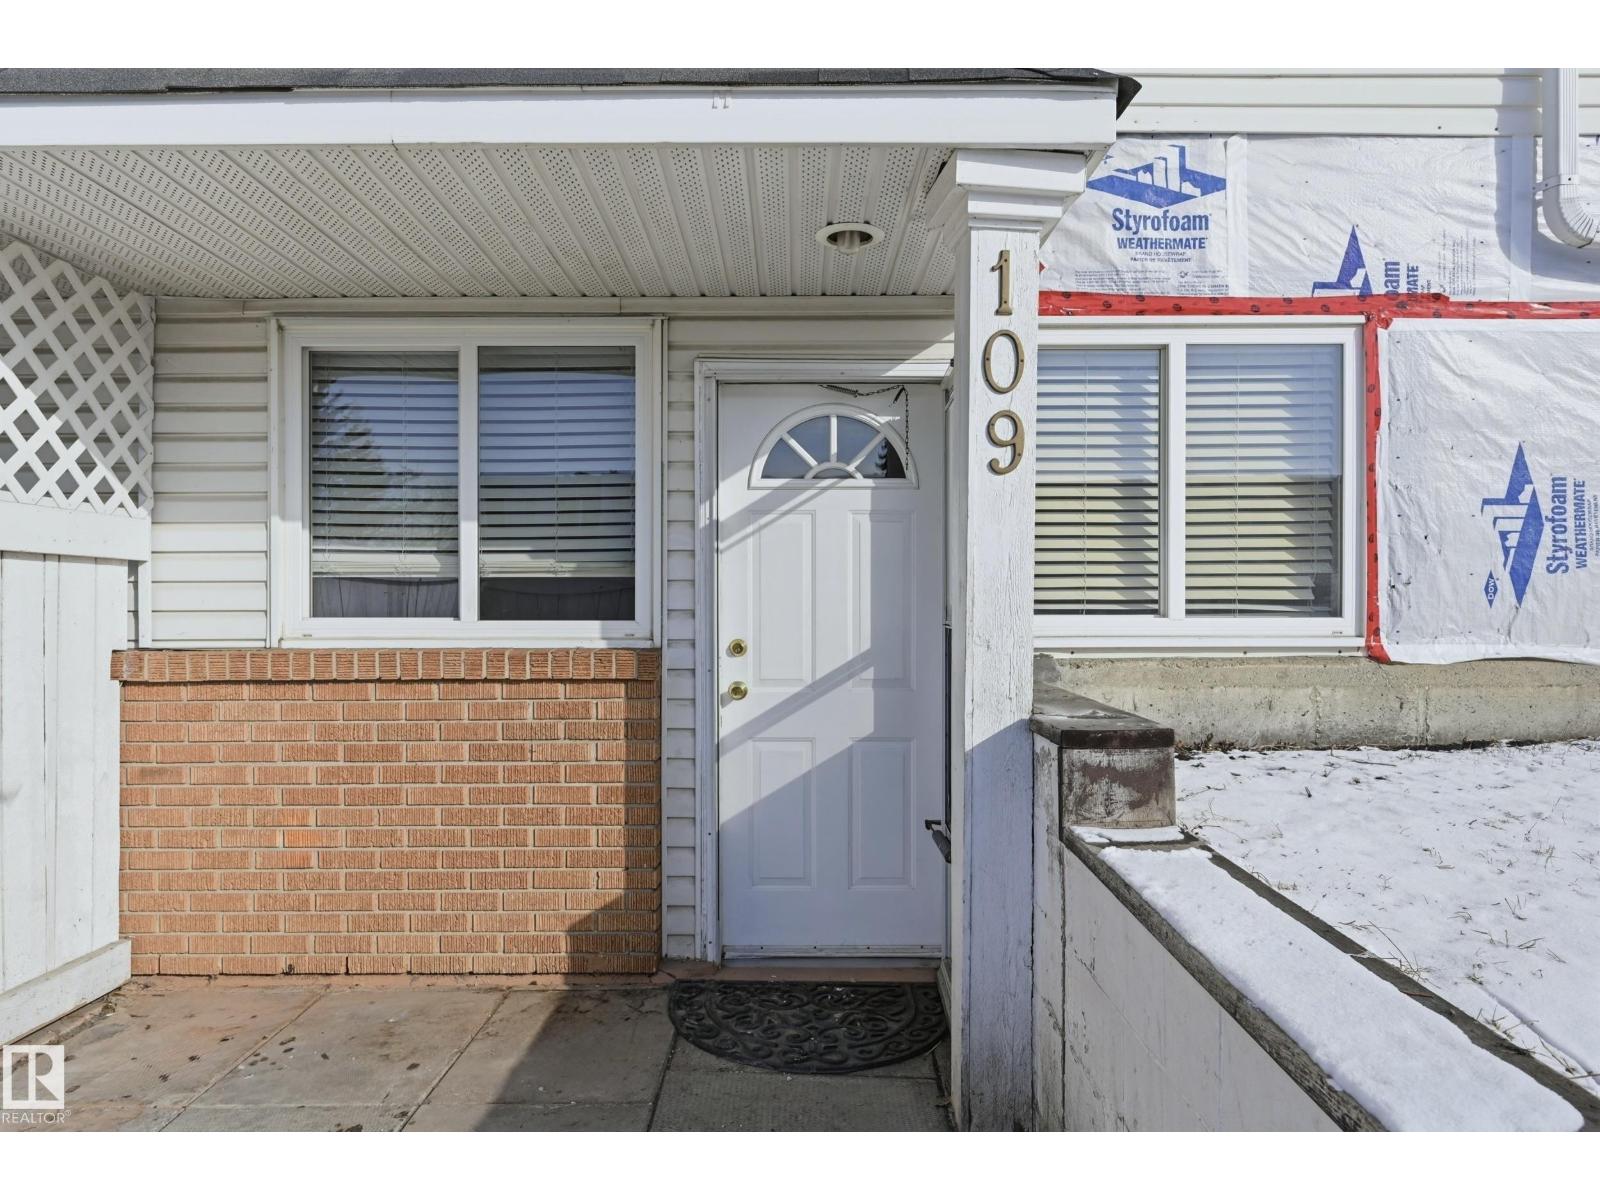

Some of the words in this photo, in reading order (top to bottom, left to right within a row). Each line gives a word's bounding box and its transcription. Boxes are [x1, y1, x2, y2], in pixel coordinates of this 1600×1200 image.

[1112, 207, 1209, 235] Styrofoam
[1117, 237, 1206, 250] WEATHERMATE
[983, 249, 1025, 476] 109
[1545, 476, 1572, 575] Styrofoam
[1573, 479, 1588, 569] WEATHERMATE
[1487, 578, 1495, 600] DOW
